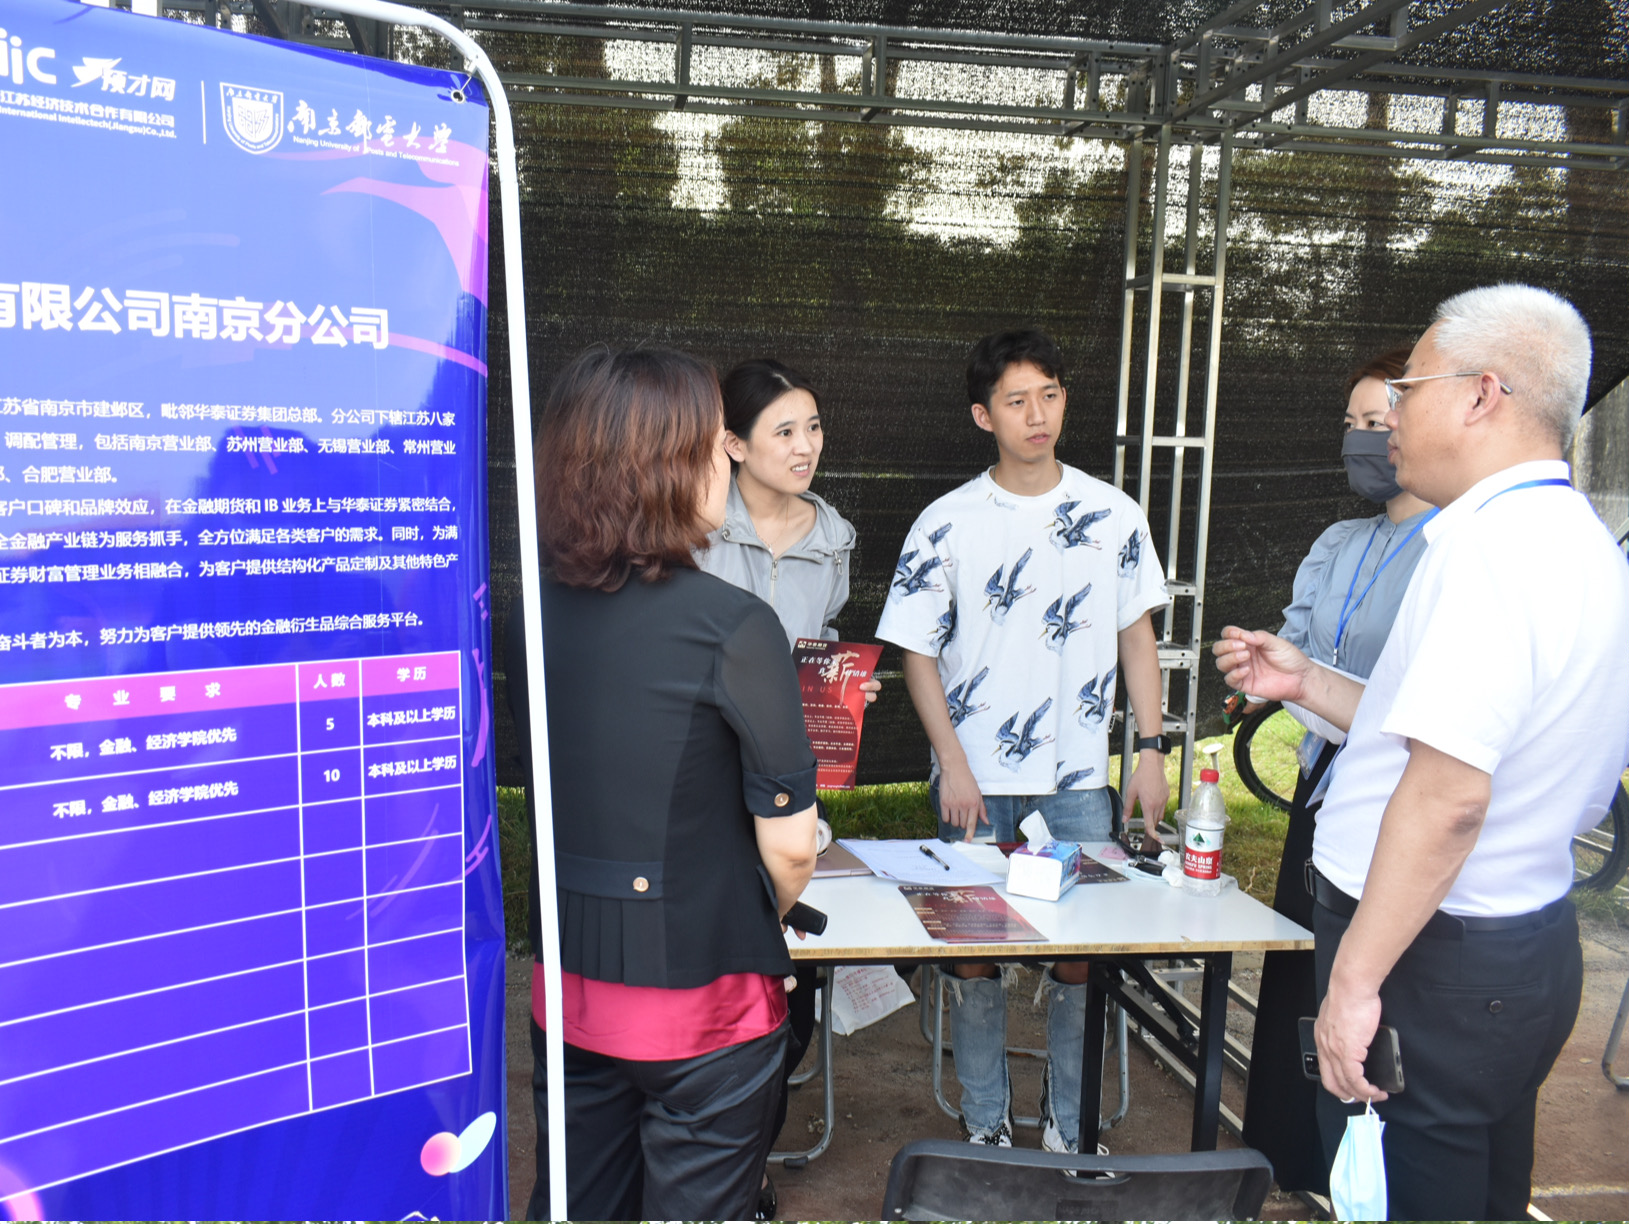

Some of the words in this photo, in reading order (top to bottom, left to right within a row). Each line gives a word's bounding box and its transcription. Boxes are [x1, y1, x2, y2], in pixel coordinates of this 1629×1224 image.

[293, 135, 318, 148] Nanjing
[319, 138, 352, 153] University
[0, 397, 456, 426] 苏省南京市建邺区，毗邻华泰证券集团总部。分公司下辖江苏八家
[0, 465, 118, 484] 、合肥营业部。
[264, 499, 279, 512] IB
[314, 673, 346, 689] 人数
[397, 666, 427, 682] 学历
[326, 717, 335, 731] 5
[367, 705, 456, 728] 本科及以上学历
[368, 755, 457, 778] 本科及以上学历
[323, 768, 341, 783] 10
